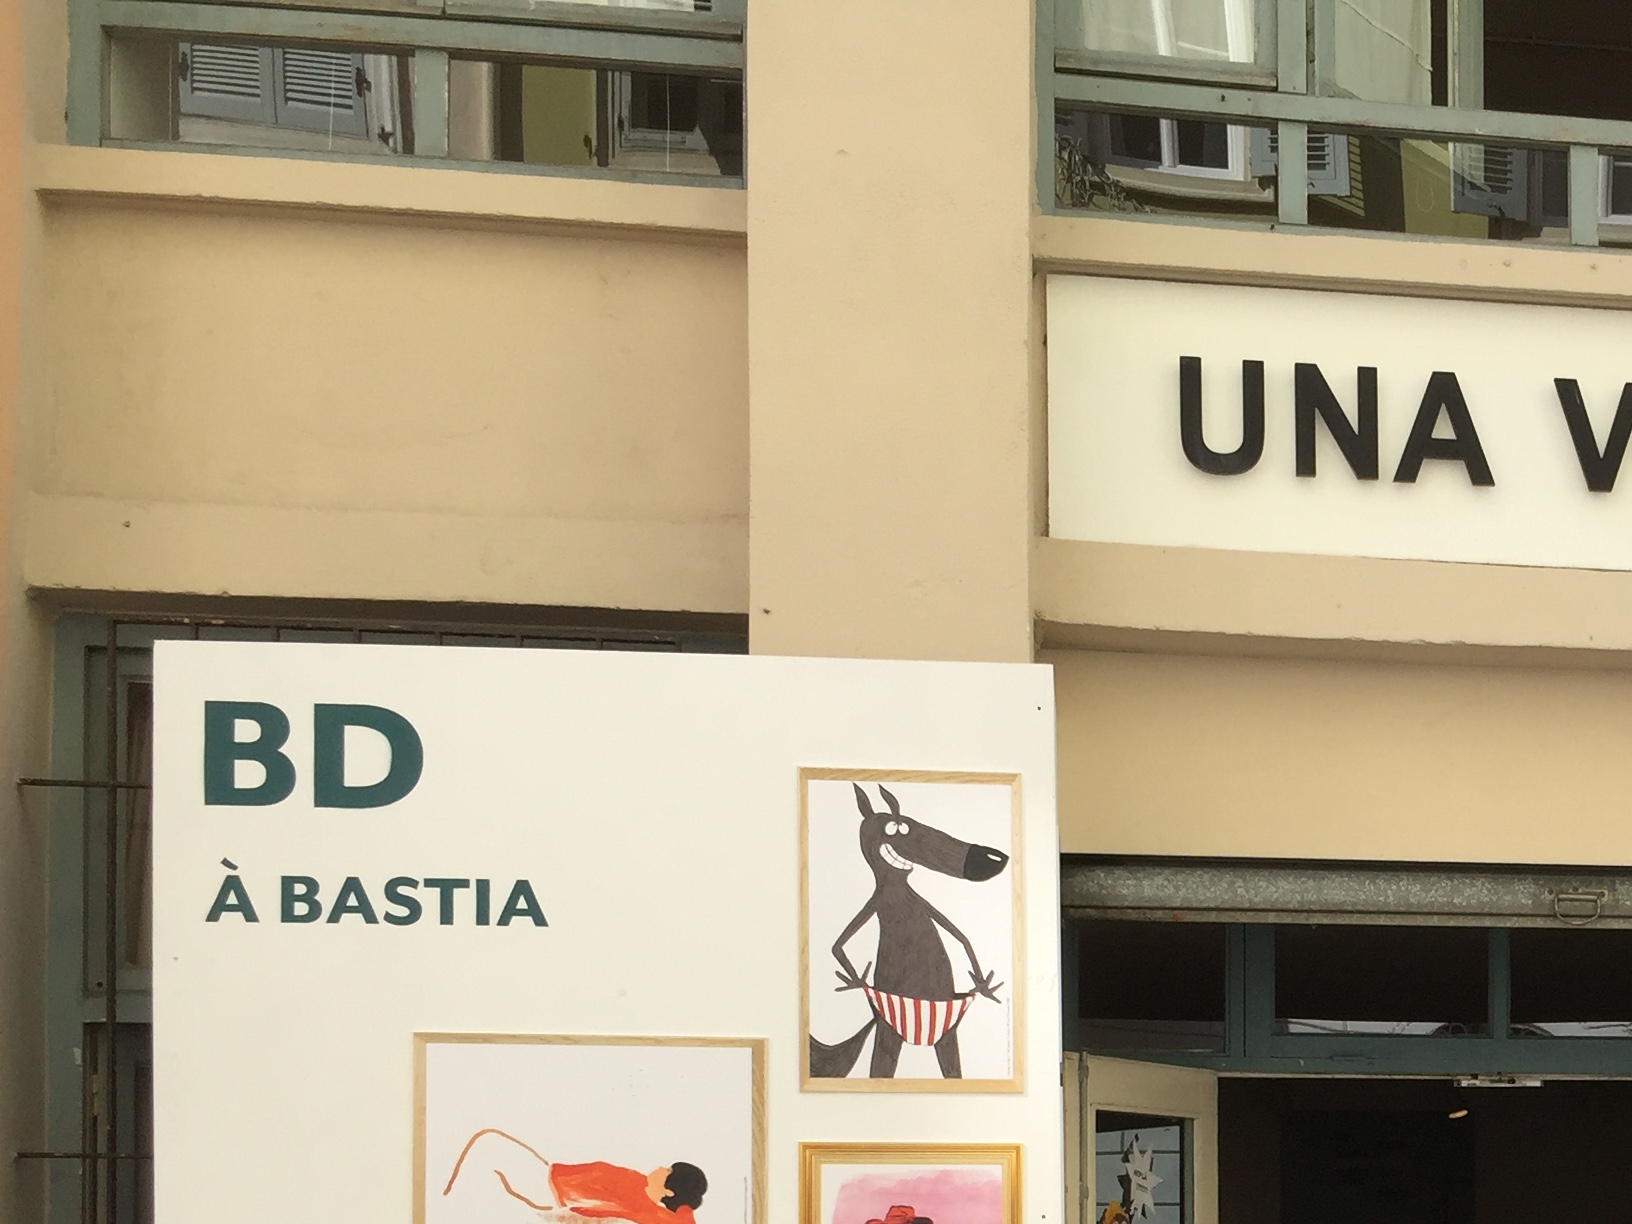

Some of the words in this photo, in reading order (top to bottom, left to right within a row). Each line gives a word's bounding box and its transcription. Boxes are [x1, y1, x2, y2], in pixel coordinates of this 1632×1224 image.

[1180, 356, 1495, 486] UNA
[204, 701, 424, 809] BD
[205, 858, 260, 923] À
[280, 875, 549, 928] BASTIA
